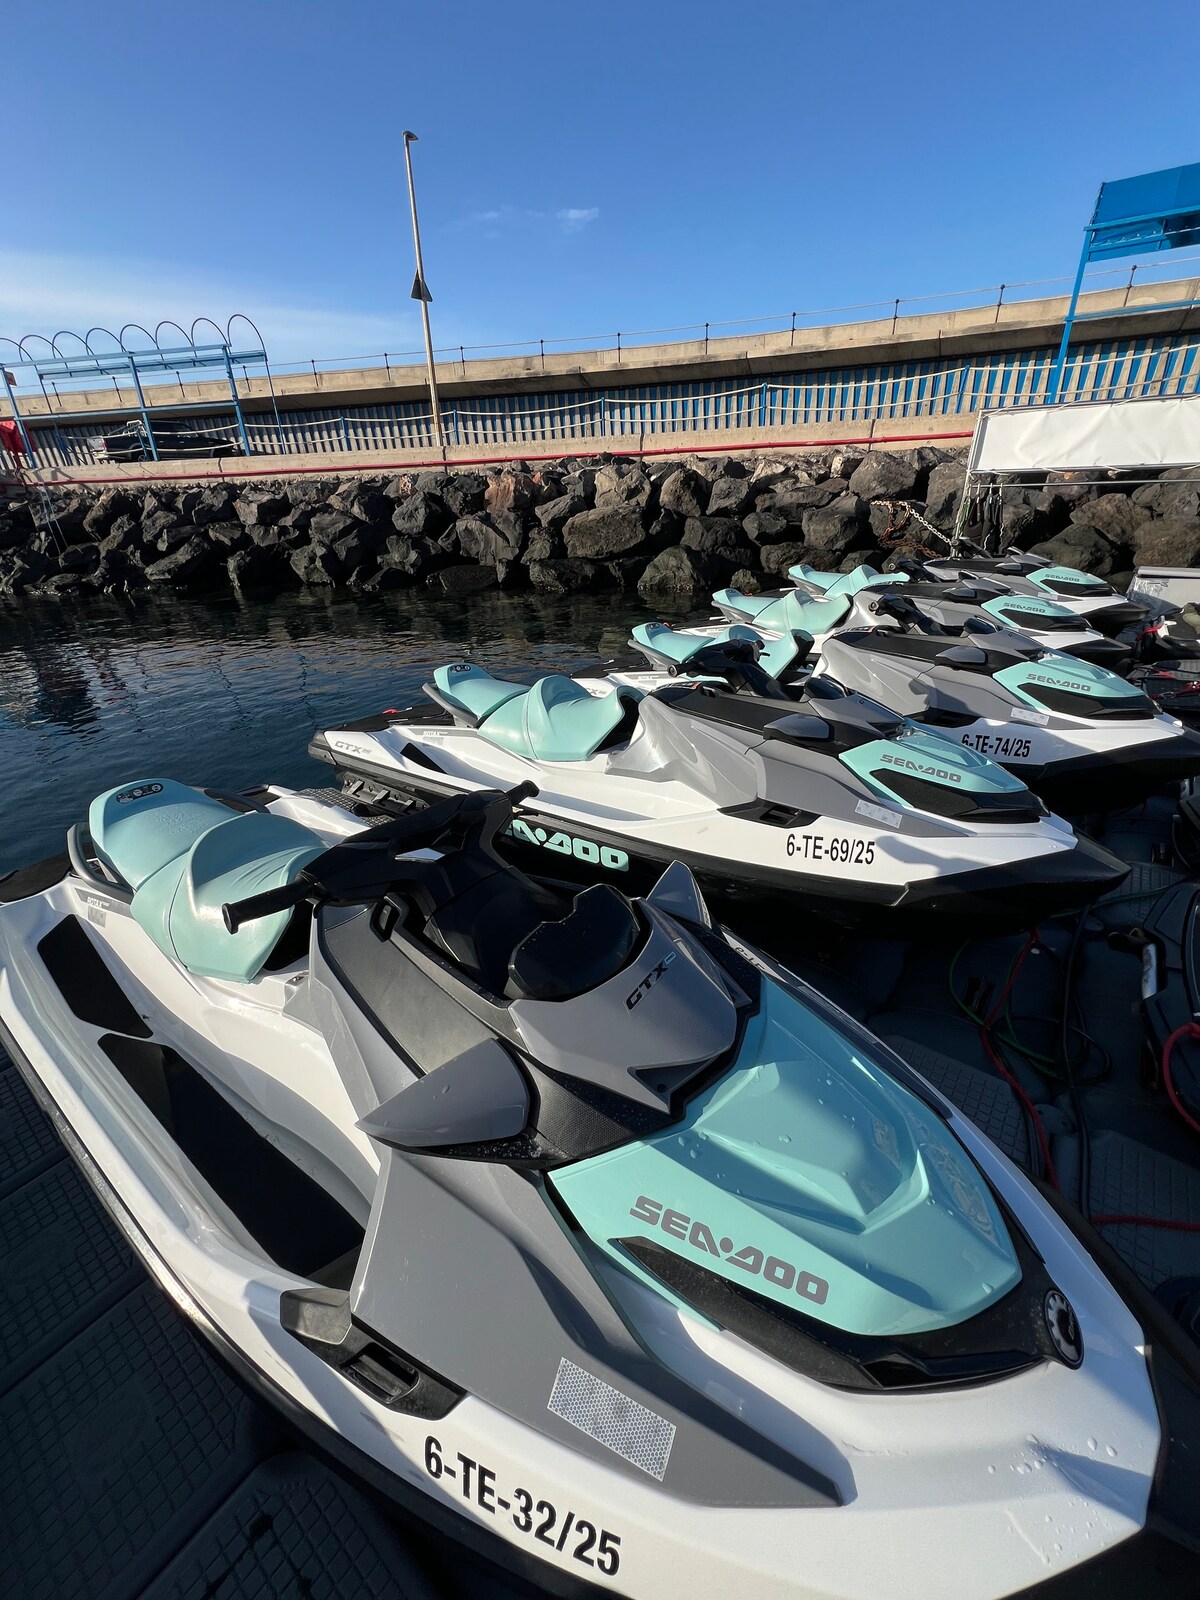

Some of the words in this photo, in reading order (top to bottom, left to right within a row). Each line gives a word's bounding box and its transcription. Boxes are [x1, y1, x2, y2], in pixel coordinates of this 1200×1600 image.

[786, 833, 875, 865] 6-TE-69/25
[625, 961, 669, 1011] GTX
[424, 1435, 622, 1577] 6-TE-32/25
